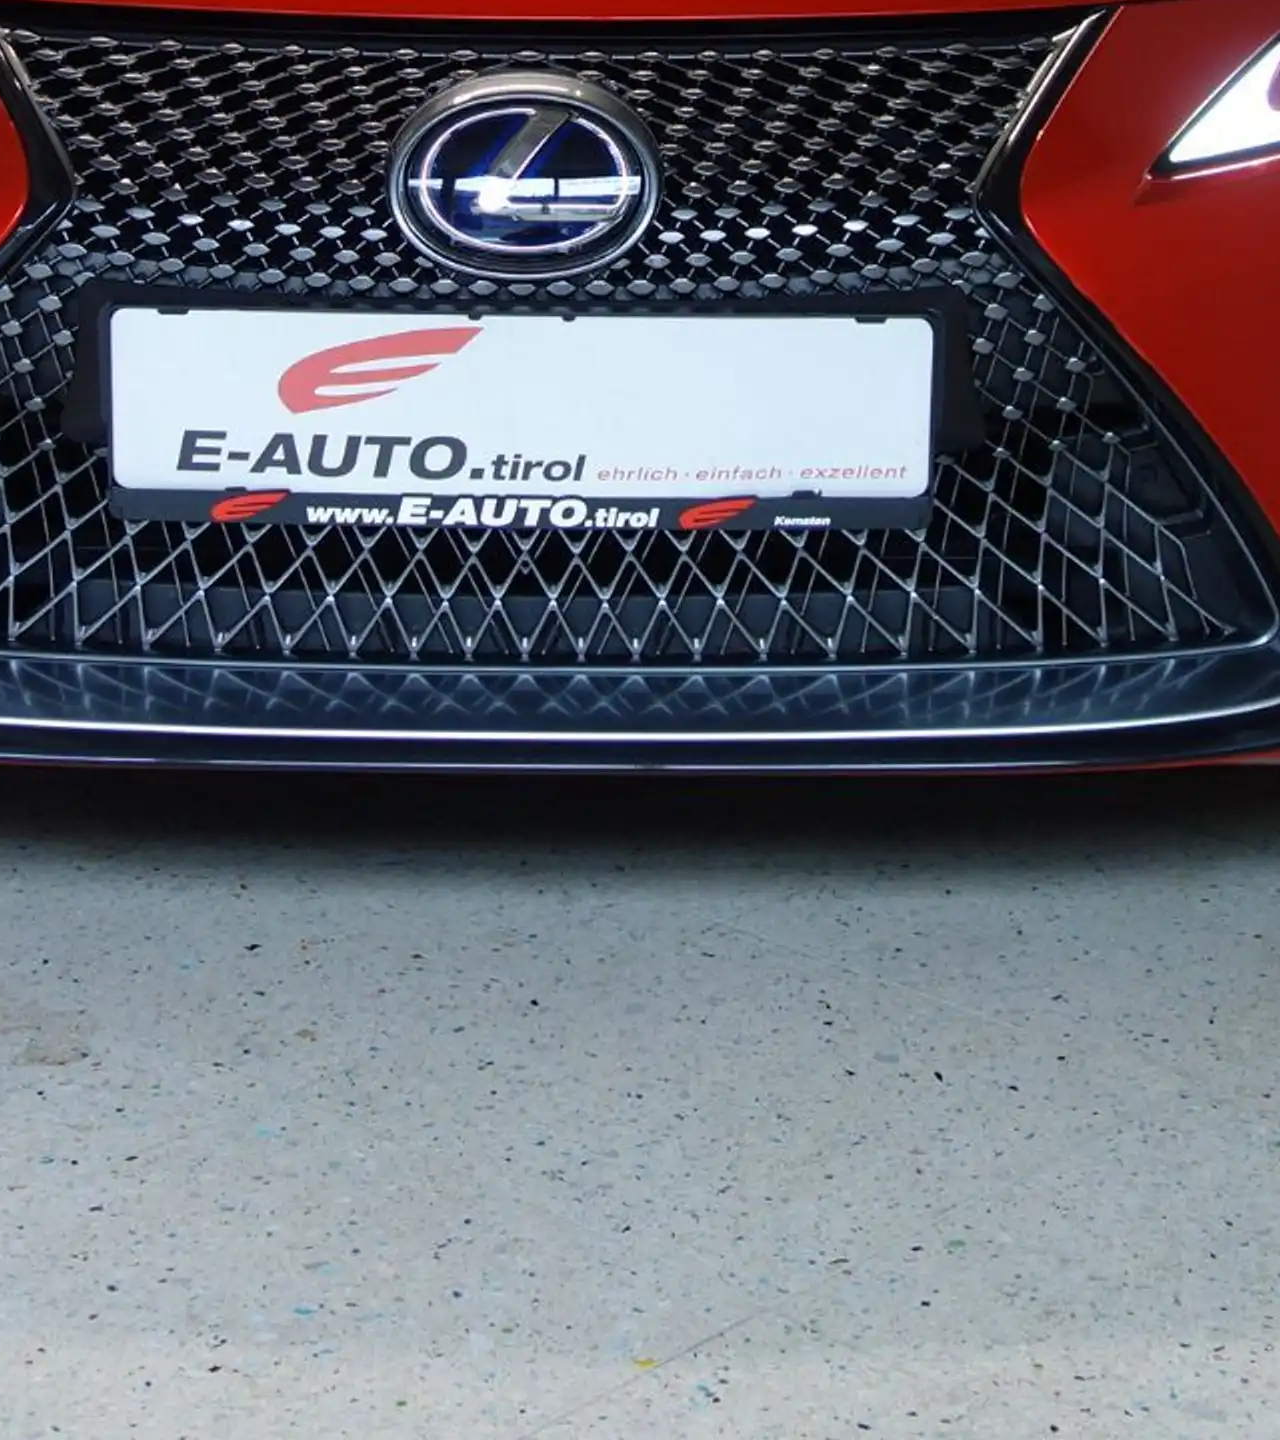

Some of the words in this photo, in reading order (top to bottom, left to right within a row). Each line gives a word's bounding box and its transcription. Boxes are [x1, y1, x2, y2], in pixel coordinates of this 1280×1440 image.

[177, 430, 587, 482] E-AUTO.tirol
[596, 465, 678, 482] ehrlich
[695, 464, 782, 482] einfach
[799, 464, 908, 480] exzellent
[306, 495, 660, 528] www.E-AUTO.tirol
